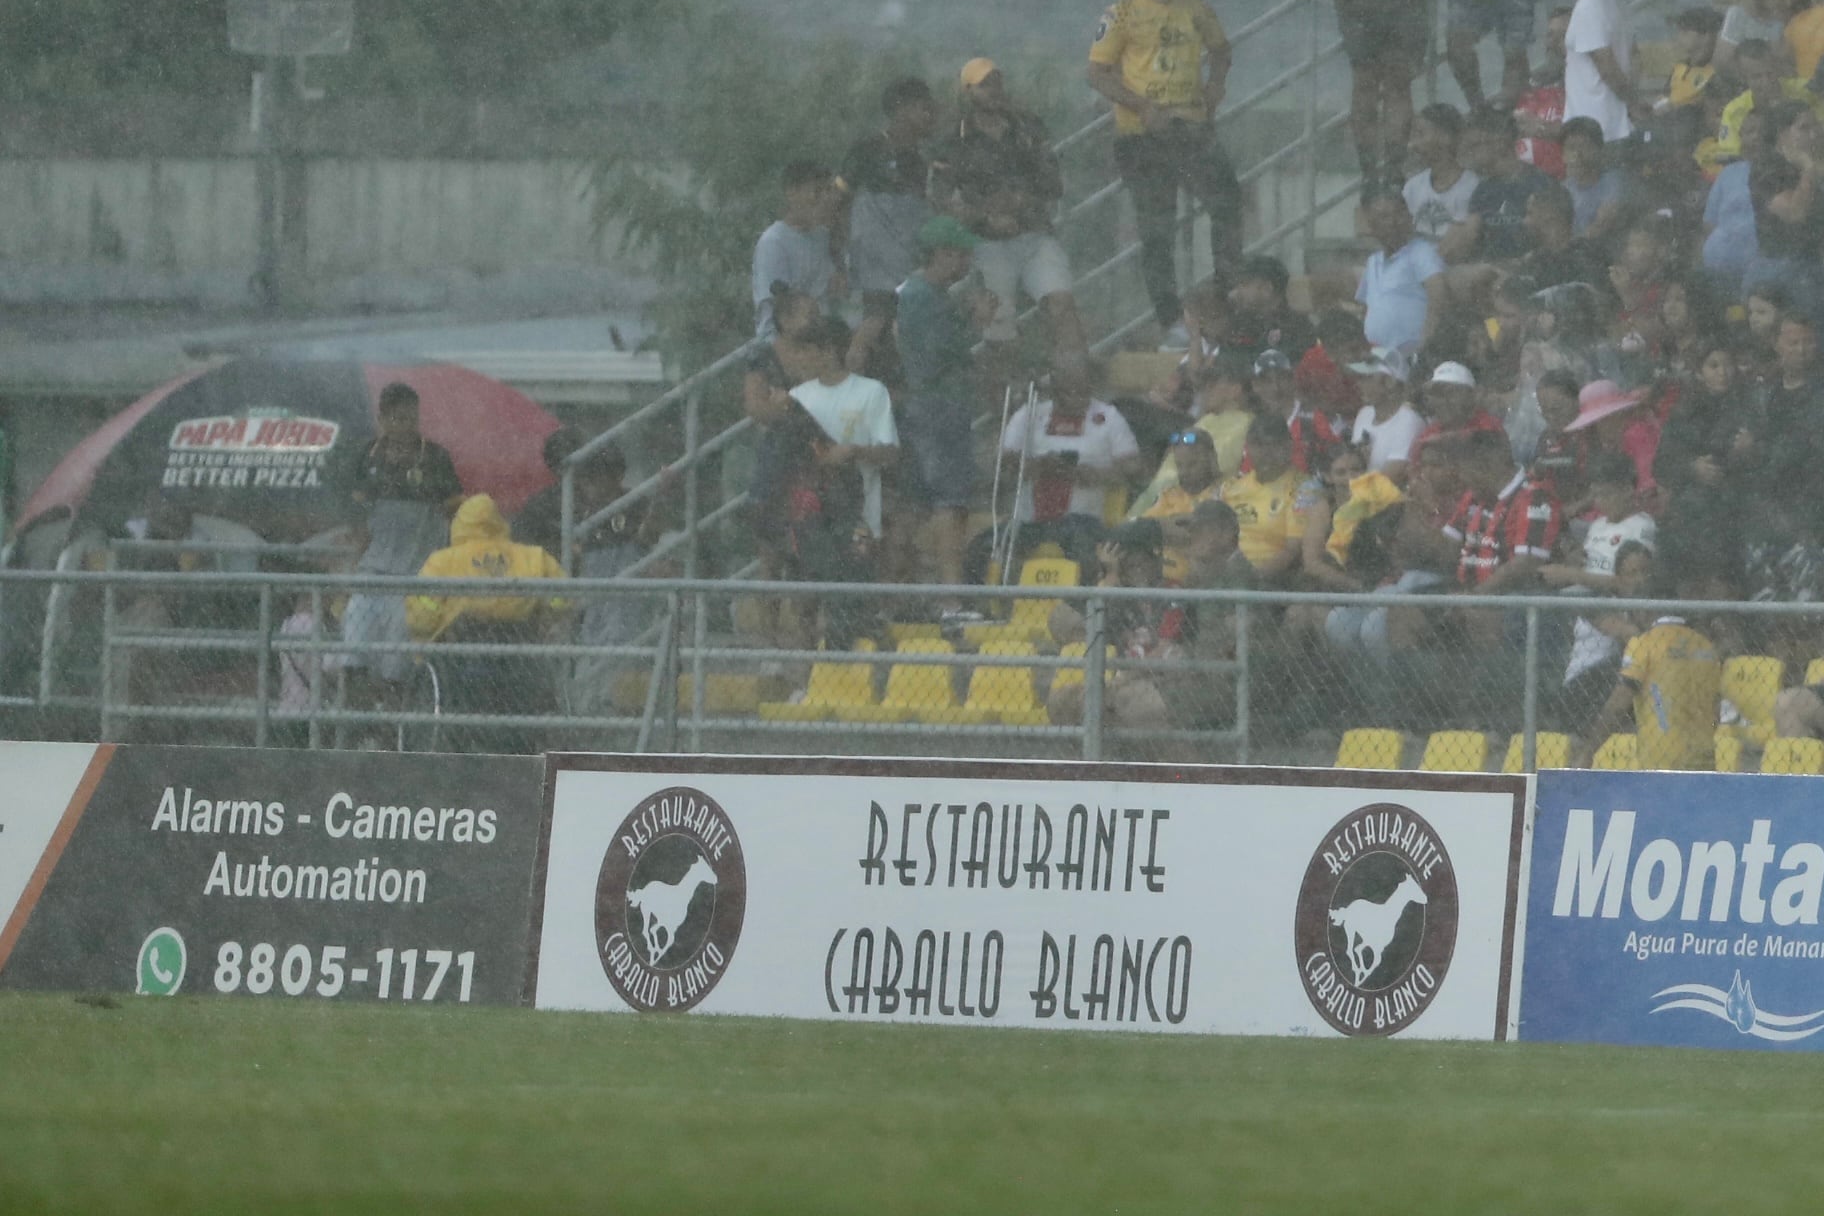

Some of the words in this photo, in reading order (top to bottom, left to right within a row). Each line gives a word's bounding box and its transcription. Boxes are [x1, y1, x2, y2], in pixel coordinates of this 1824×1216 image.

[162, 467, 248, 487] BETTER
[152, 787, 285, 836] Alarms
[325, 792, 498, 844] Cameras
[622, 796, 732, 861] RESTAURANTE
[860, 799, 1171, 894] RESTAURANTE
[1323, 812, 1443, 881] RESTAURANTE
[203, 851, 427, 903] Automation
[214, 941, 476, 1003] 8805-1171
[604, 932, 660, 1007] CABALLO
[667, 942, 724, 1007] BLANCO
[824, 925, 1005, 1018] CABALLO
[1029, 931, 1193, 1025] BLANCO
[1623, 930, 1675, 961] Agua
[1681, 932, 1728, 956] Pura
[1733, 933, 1759, 956] de
[1305, 952, 1366, 1029] CABALLO
[1373, 963, 1435, 1029] BLANCO
